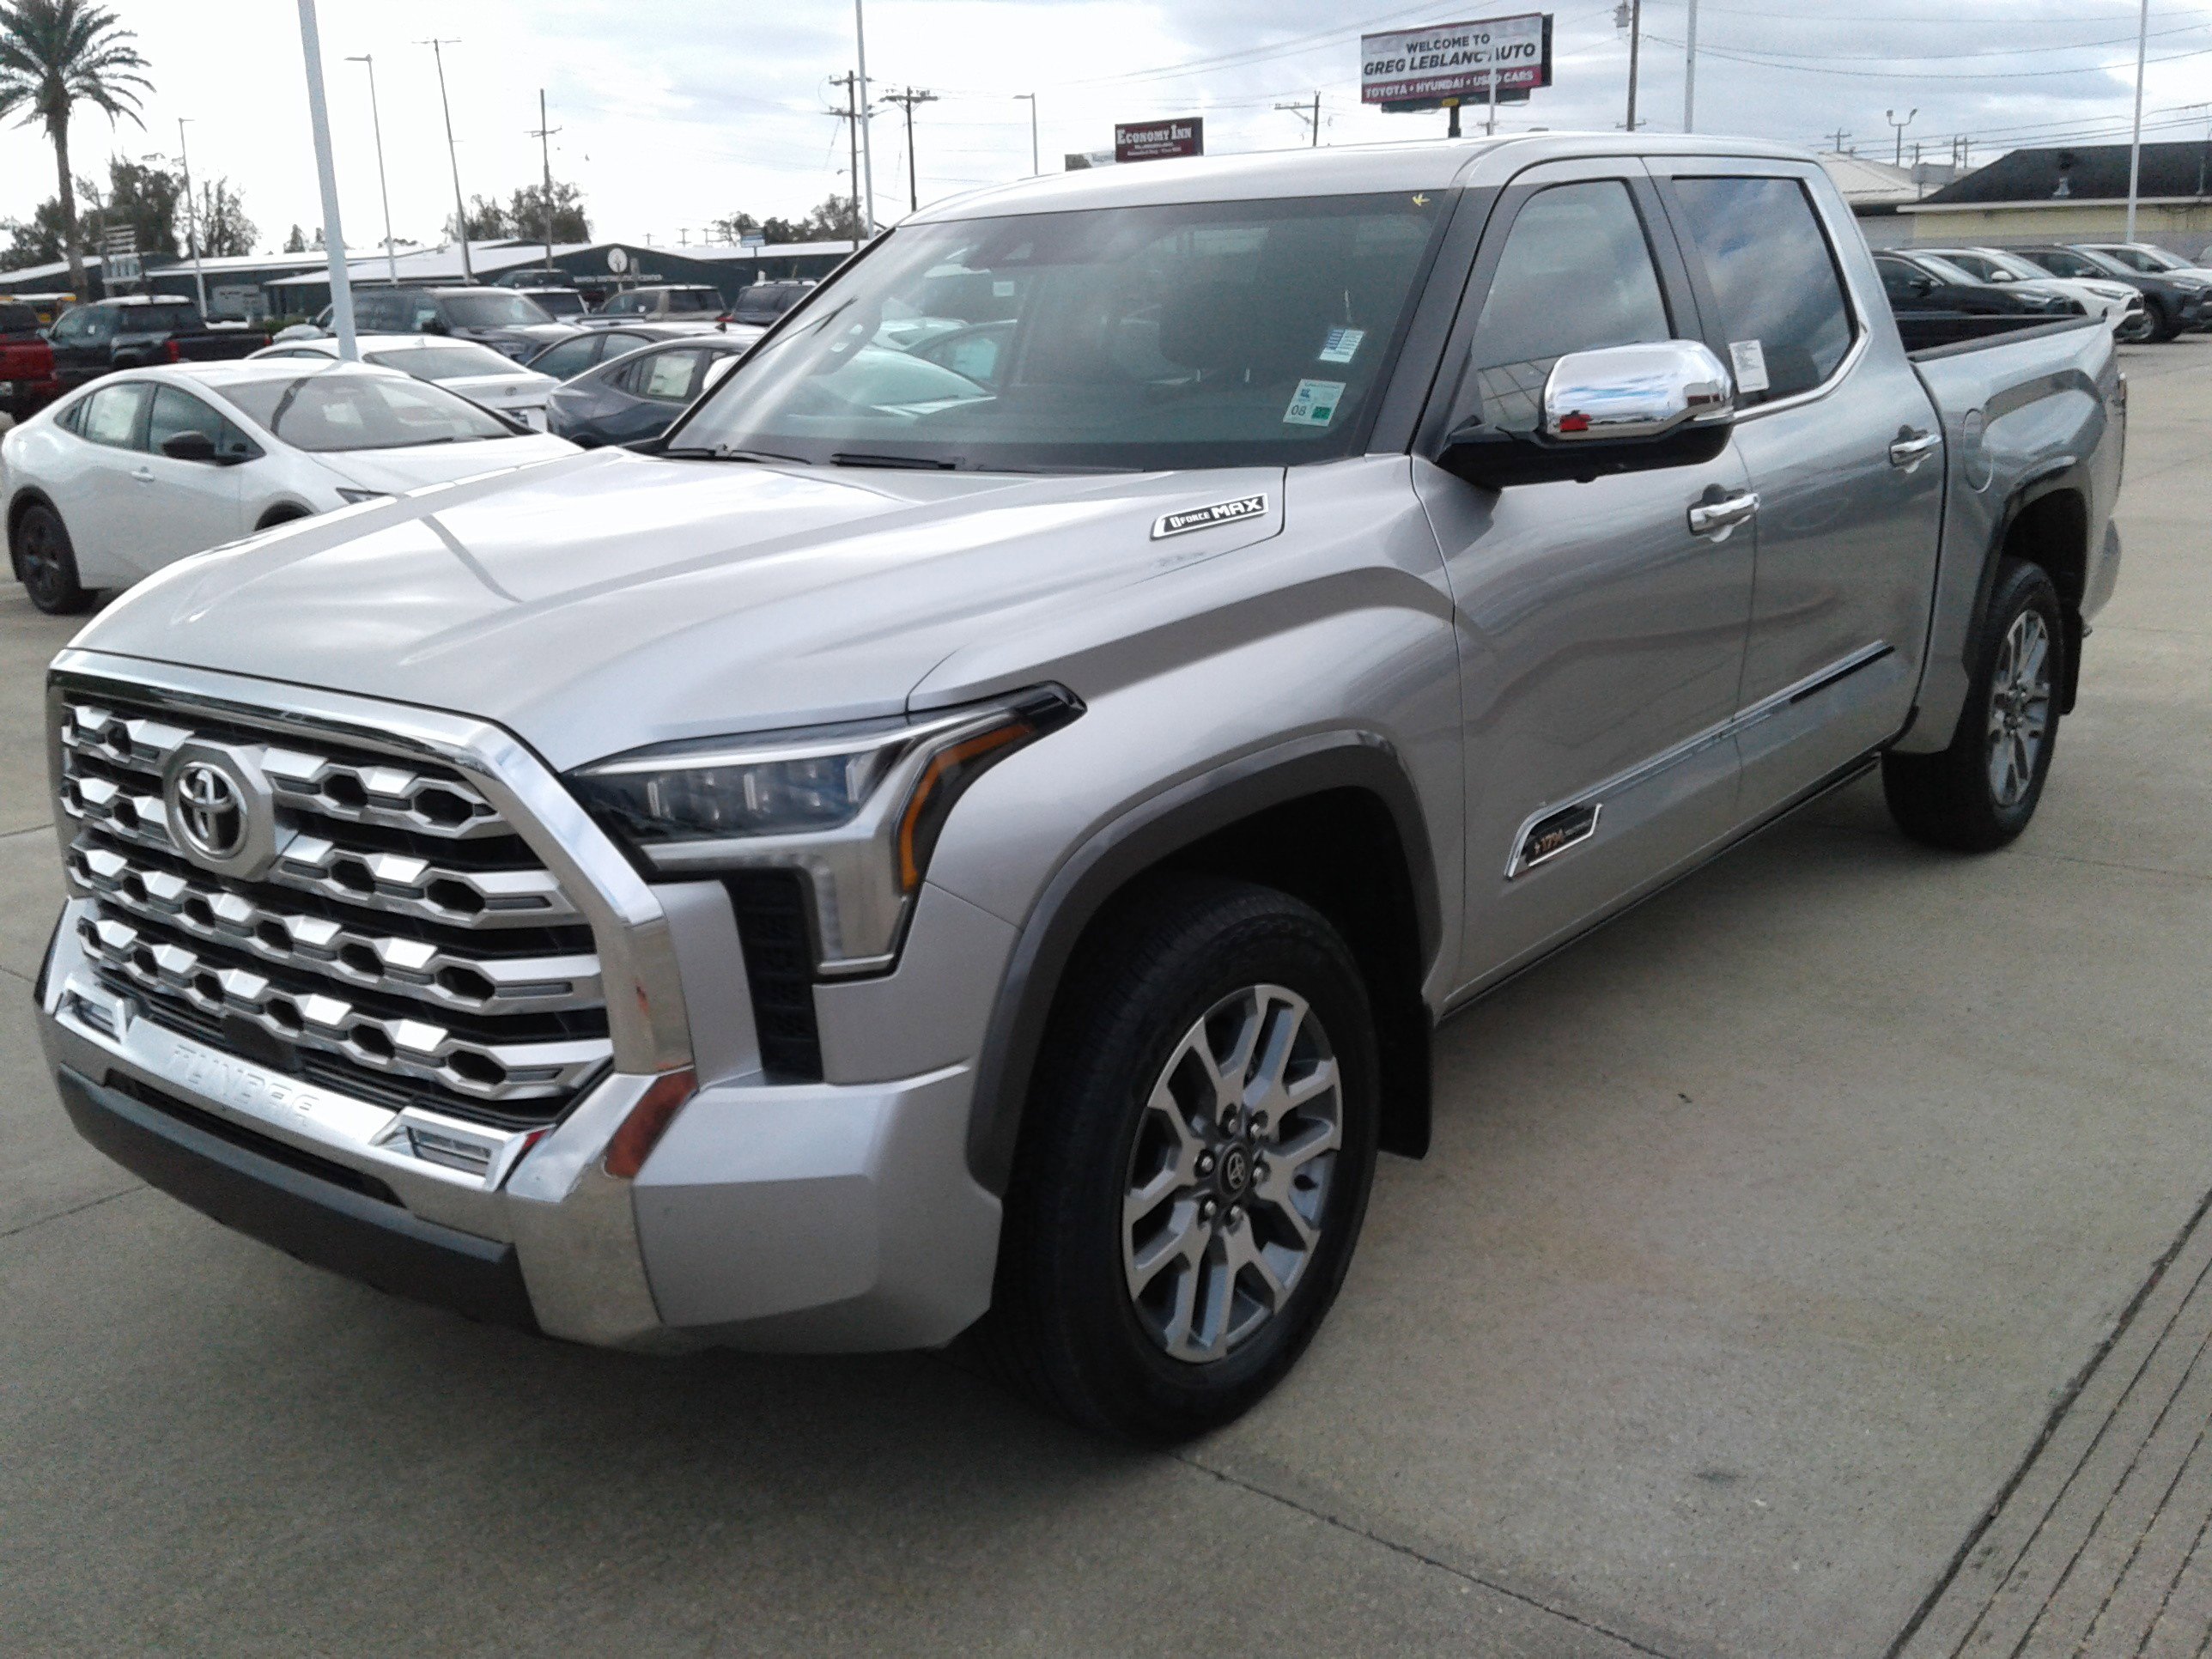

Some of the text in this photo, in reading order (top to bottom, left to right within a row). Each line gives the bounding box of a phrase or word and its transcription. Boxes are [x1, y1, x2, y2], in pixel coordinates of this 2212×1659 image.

[1406, 33, 1491, 53] WELCOME TO
[1364, 58, 1406, 76] GREG
[1409, 50, 1487, 70] LEBLANC
[1366, 84, 1407, 99] TOYOTA
[1416, 76, 1465, 94] HYUNDAI
[1504, 70, 1534, 83] CARS
[1211, 497, 1262, 520] MAX
